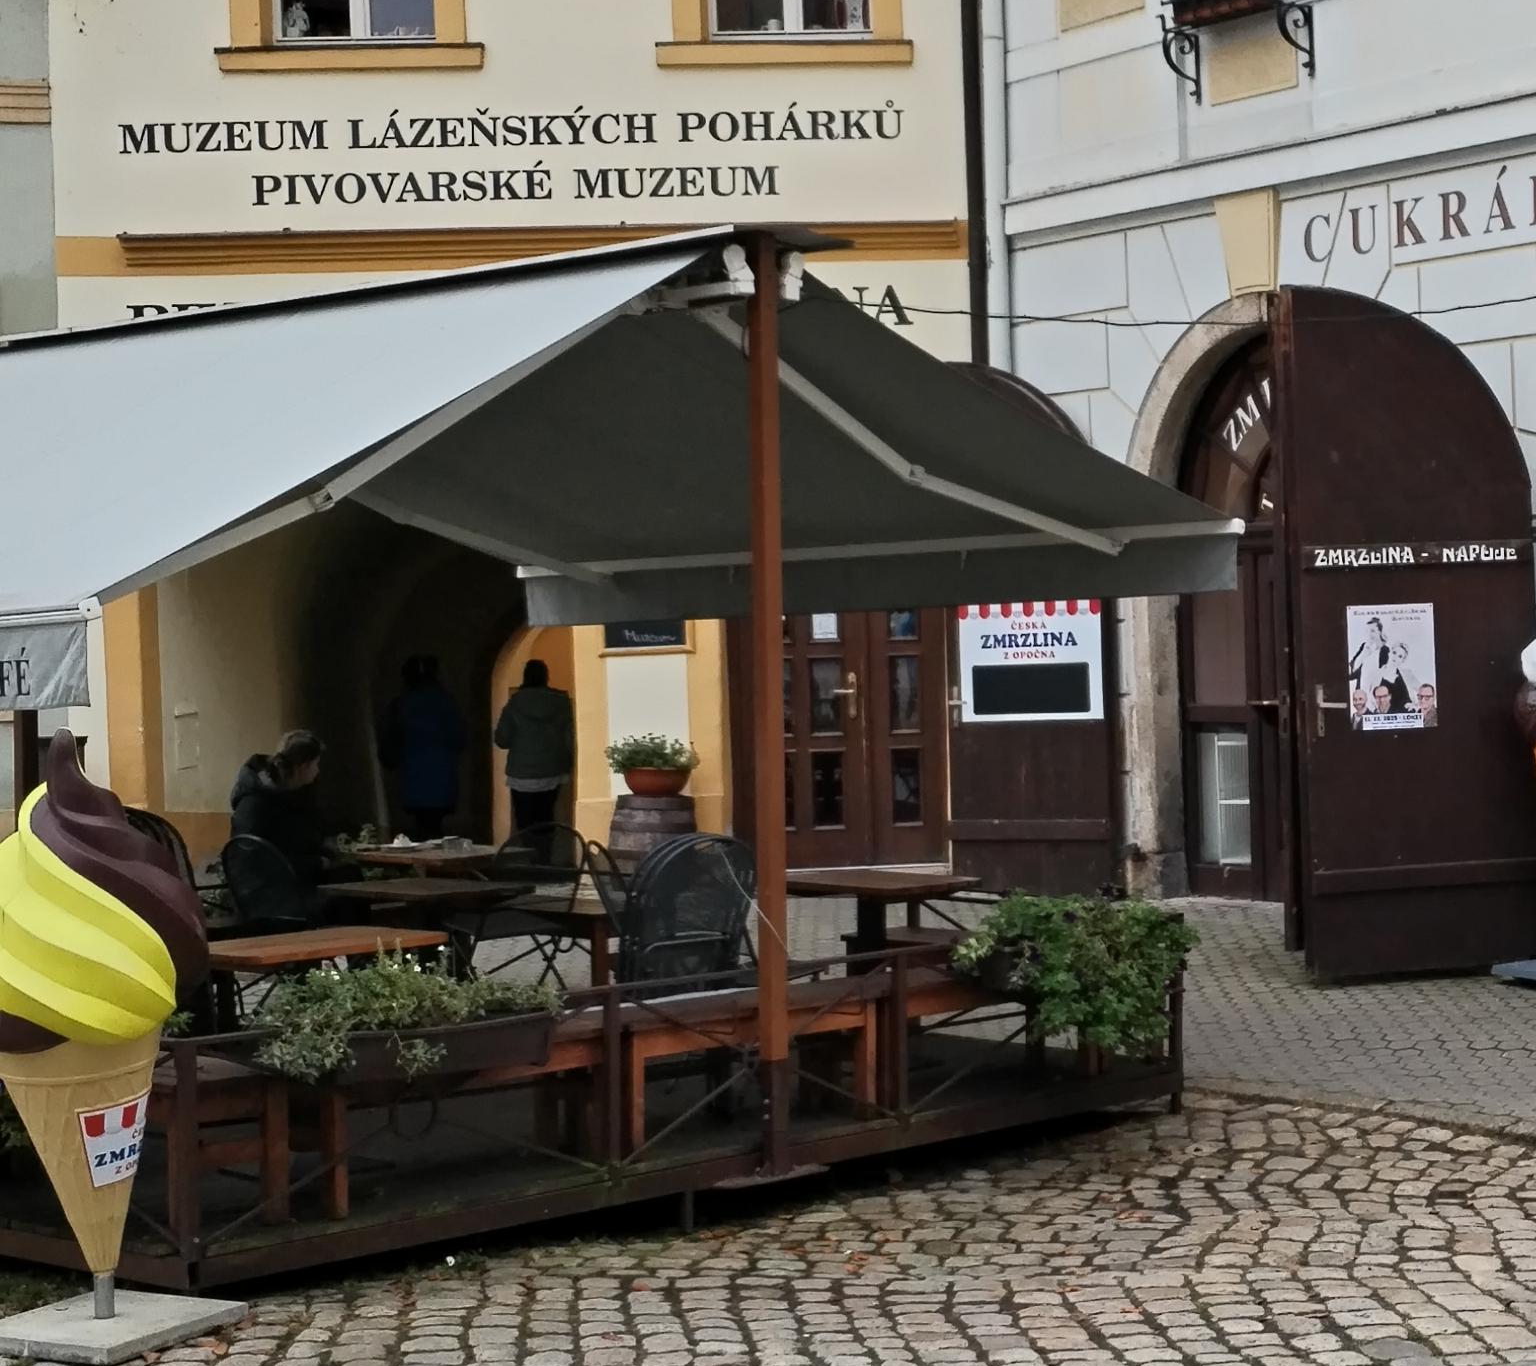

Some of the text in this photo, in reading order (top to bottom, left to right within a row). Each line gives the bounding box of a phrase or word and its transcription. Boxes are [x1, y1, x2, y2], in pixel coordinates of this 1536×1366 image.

[118, 100, 905, 154] MUZEUM LÁZEŇSKÝCH POHÁRKŮ
[251, 160, 781, 206] PIVOVARSKÉ MUZEUM
[1314, 545, 1416, 567] ZMRZLINA
[1010, 618, 1048, 632] ČESKÁ
[981, 631, 1079, 650] ZMRZLINA
[1003, 649, 1057, 660] Z OPOČNA
